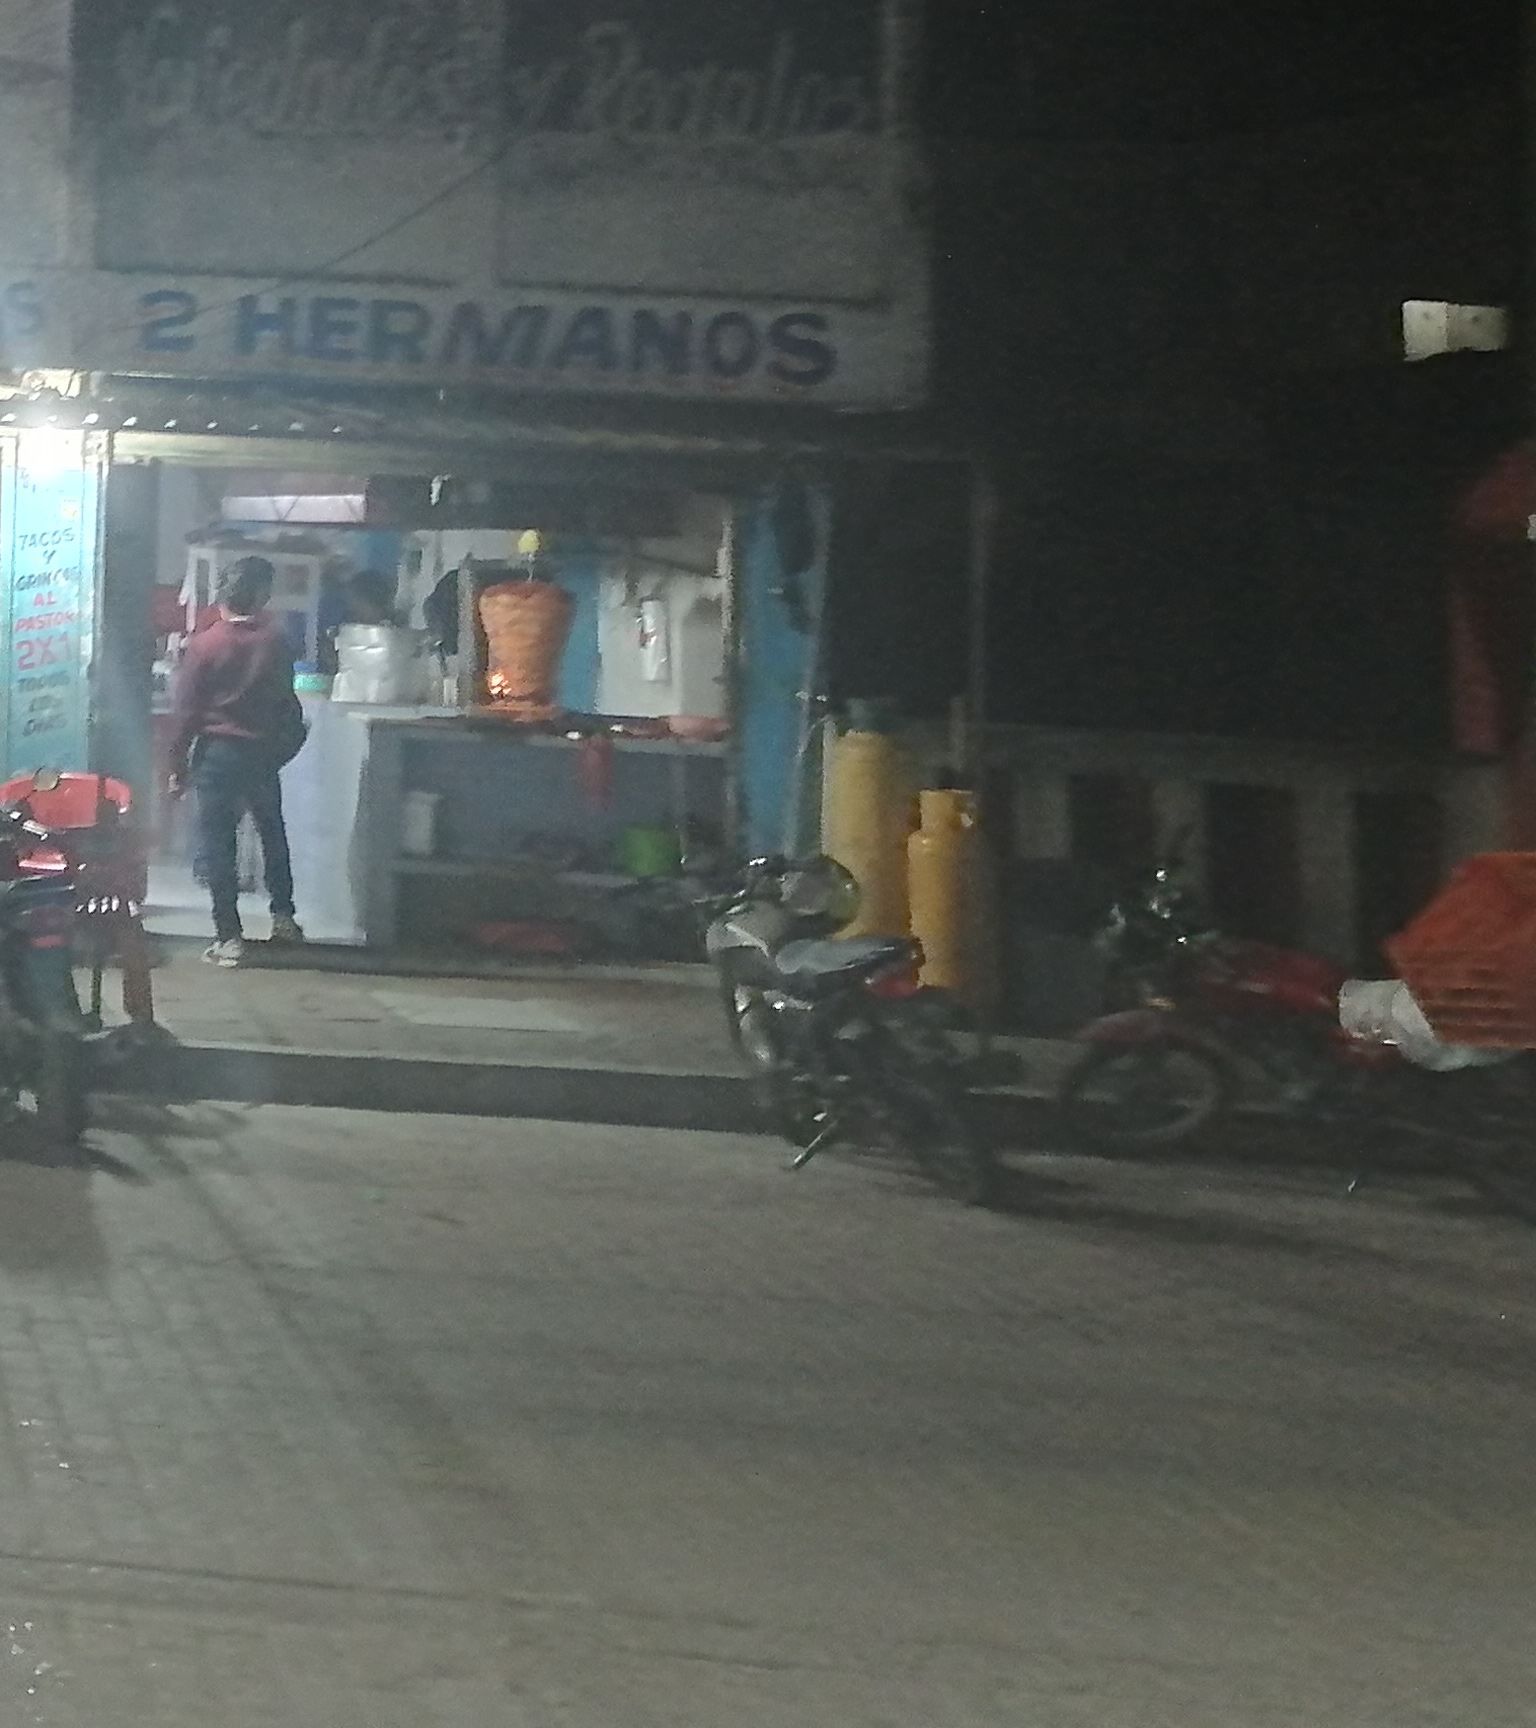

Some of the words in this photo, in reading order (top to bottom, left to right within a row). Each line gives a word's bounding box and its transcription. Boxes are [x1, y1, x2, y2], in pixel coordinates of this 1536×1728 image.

[137, 289, 197, 357] 2
[232, 294, 838, 387] HERMANOS
[18, 527, 75, 551] TACOS
[33, 591, 57, 607] AL
